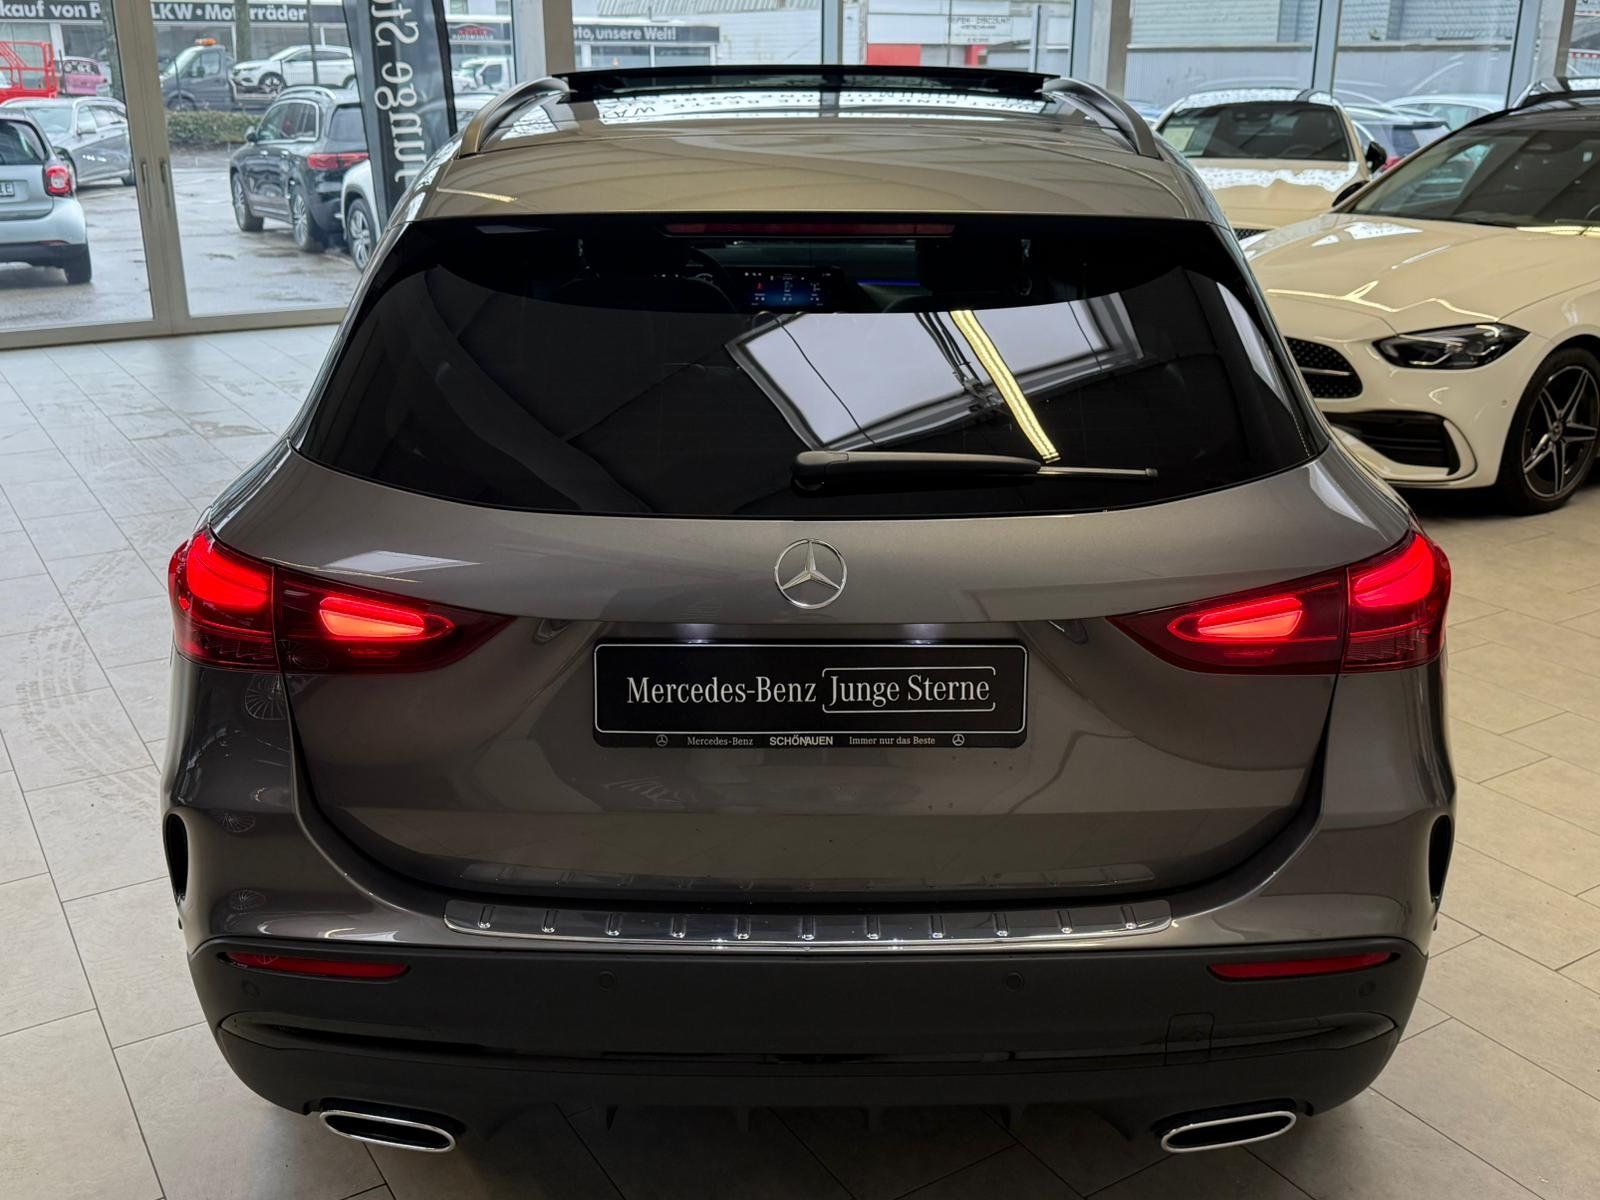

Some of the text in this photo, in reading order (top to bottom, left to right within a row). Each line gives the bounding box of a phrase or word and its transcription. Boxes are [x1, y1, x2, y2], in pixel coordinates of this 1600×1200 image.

[49, 4, 87, 18] von
[151, 3, 193, 19] LKW
[205, 4, 307, 20] Motrräder
[573, 26, 677, 41] to, unsere Welt!
[626, 674, 990, 708] Mercedes-Benz Junge Sterne
[687, 736, 754, 746] Mercedes-Benz
[849, 736, 877, 745] Immer
[896, 736, 911, 745] das
[913, 736, 936, 745] Beste
